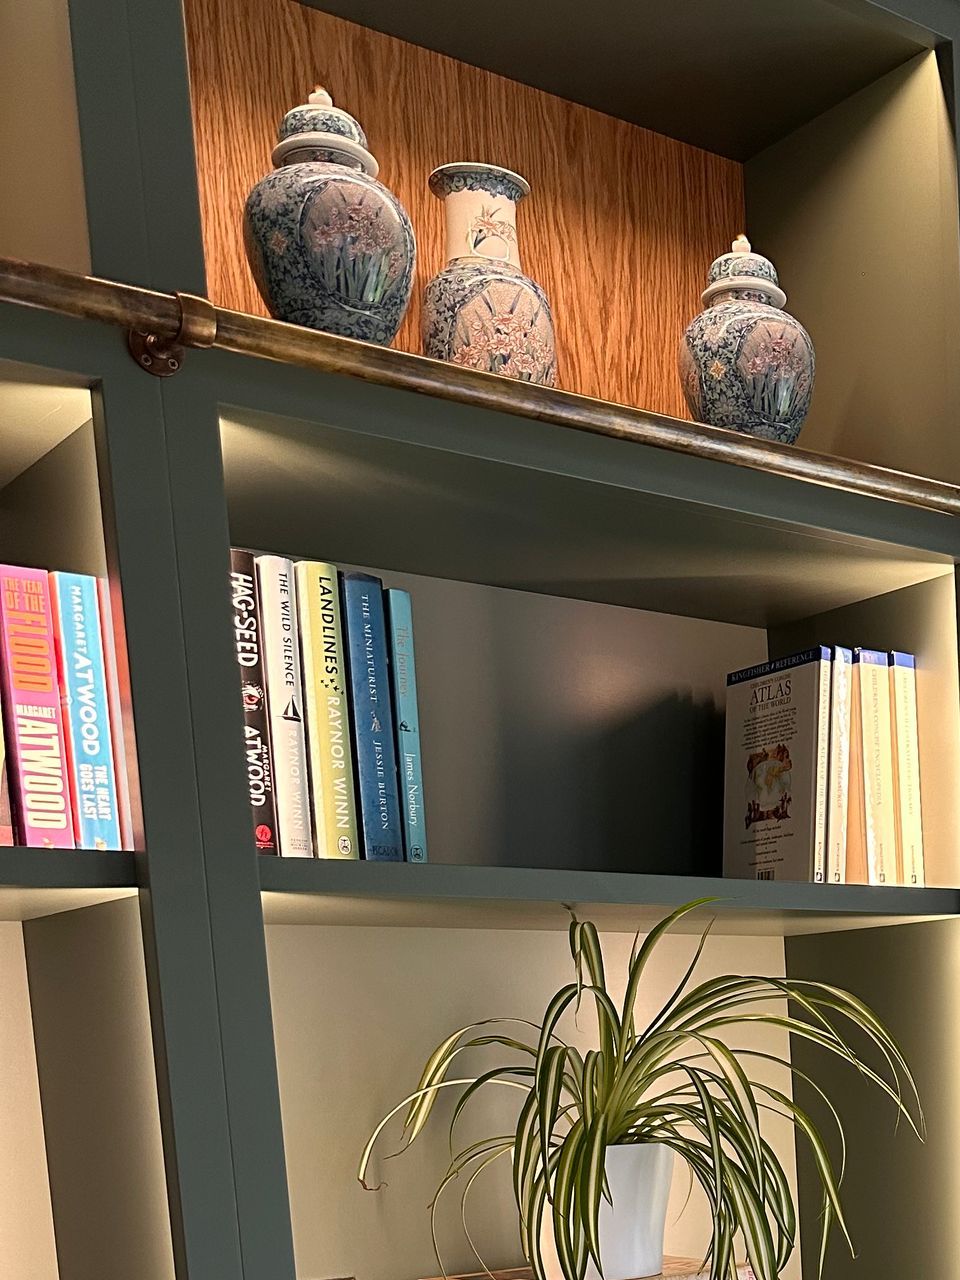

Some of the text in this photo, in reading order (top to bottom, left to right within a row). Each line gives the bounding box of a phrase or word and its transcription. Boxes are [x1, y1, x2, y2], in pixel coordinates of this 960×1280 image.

[4, 576, 43, 594] THE YEAR
[6, 591, 45, 613] OF THE
[70, 585, 87, 654] MARGARET
[230, 572, 258, 667] HAG-SEED
[6, 610, 53, 693] FLOOD
[279, 573, 295, 687] THE WILD SILENCE
[319, 576, 338, 675] LANDLINES
[361, 594, 378, 703] THE MINIATURIST
[396, 625, 409, 697] The Journey
[731, 650, 815, 681] KINGFISHER REFERENCE
[750, 680, 792, 705] ATLAS
[16, 703, 56, 719] MARGARET
[72, 652, 100, 756] ATWOOD
[749, 697, 792, 714] OF THE WORLD
[17, 717, 67, 829] ATWOOD
[80, 763, 98, 820] GOES LAST
[94, 765, 111, 821] THE HEART
[244, 726, 266, 806] ATWOOD
[261, 744, 272, 791] MARGARET
[288, 727, 300, 784] RAYNOR
[294, 791, 304, 830] WINN
[327, 696, 349, 829] RAYNOR WINN
[373, 740, 389, 830] JESSIE BURTON
[404, 753, 421, 827] James Norbury
